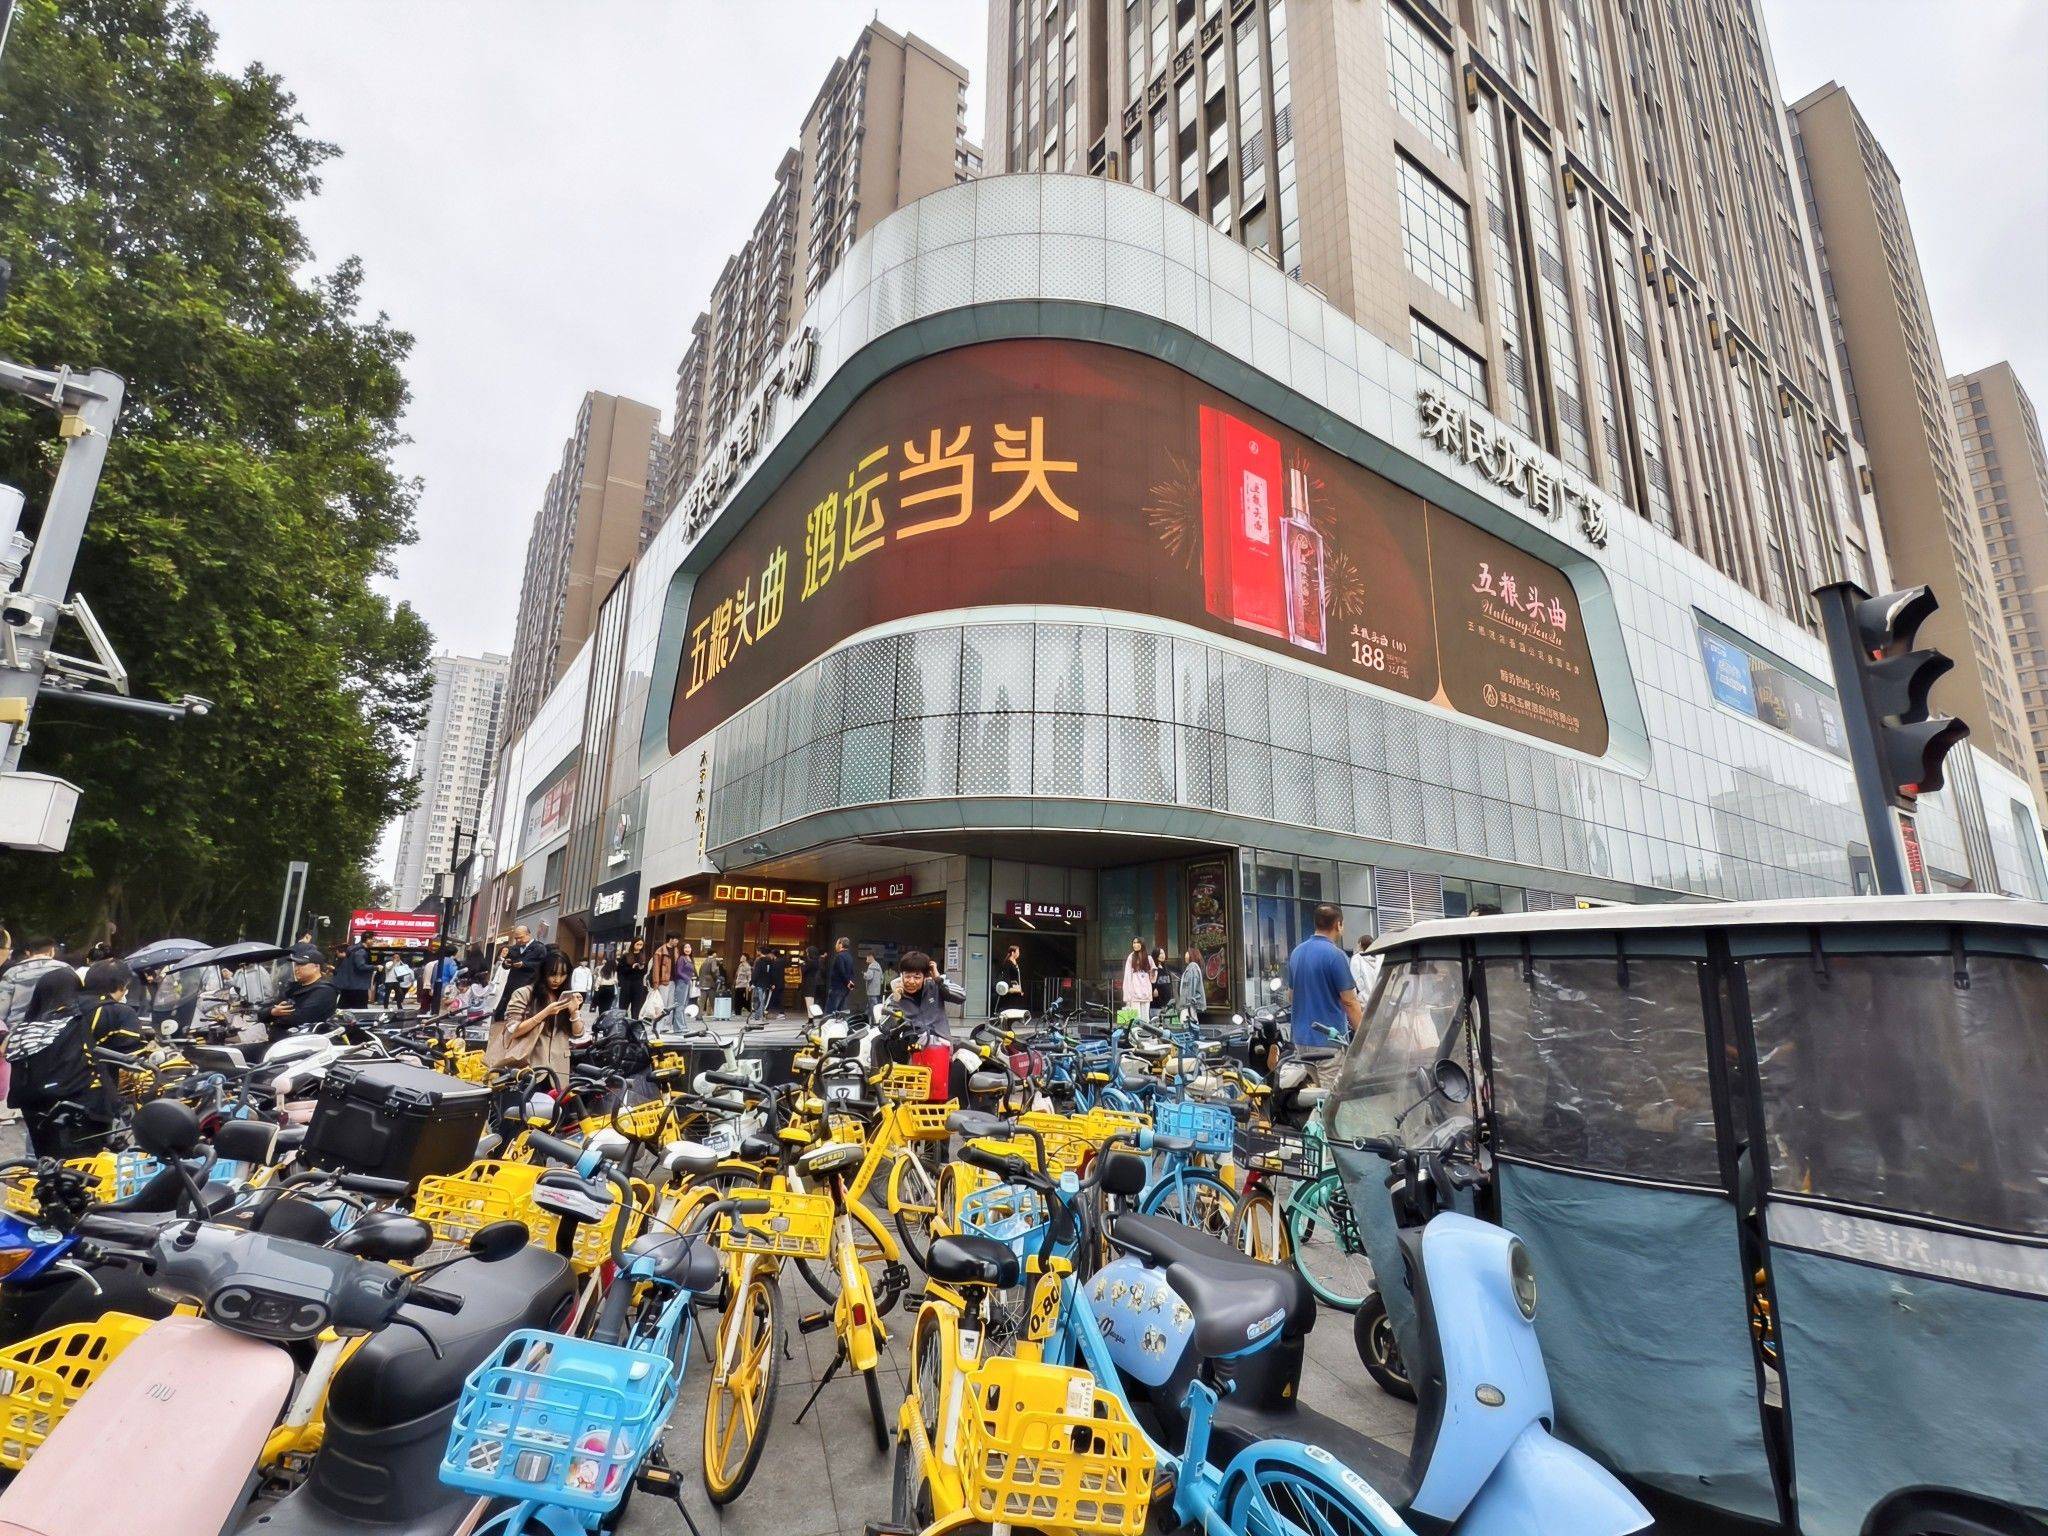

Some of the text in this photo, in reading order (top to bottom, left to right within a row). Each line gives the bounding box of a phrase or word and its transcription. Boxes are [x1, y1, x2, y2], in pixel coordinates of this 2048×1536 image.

[1417, 388, 1608, 550] 荣民龙首广场
[685, 416, 1079, 699] 五粮头曲 鸿运当头
[1471, 562, 1567, 632] 五粮头曲
[1351, 640, 1385, 671] 188
[1031, 1285, 1060, 1334] 0.80
